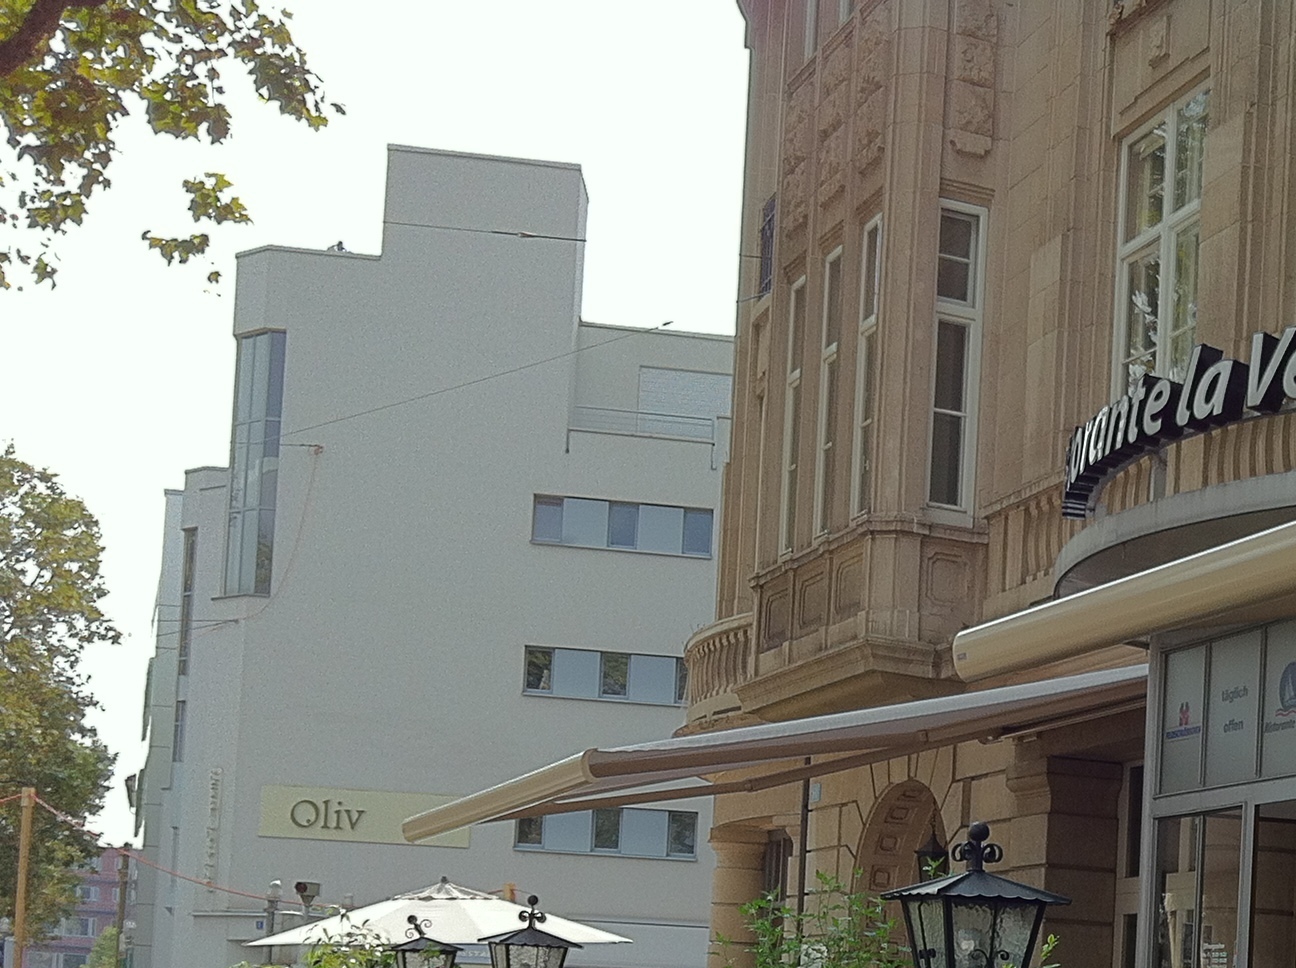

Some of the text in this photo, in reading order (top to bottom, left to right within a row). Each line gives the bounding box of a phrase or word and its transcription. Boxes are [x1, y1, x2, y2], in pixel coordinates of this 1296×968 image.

[1066, 374, 1172, 488] orante
[1176, 343, 1234, 428] la
[1222, 718, 1245, 734] offen
[290, 799, 366, 831] Oliv
